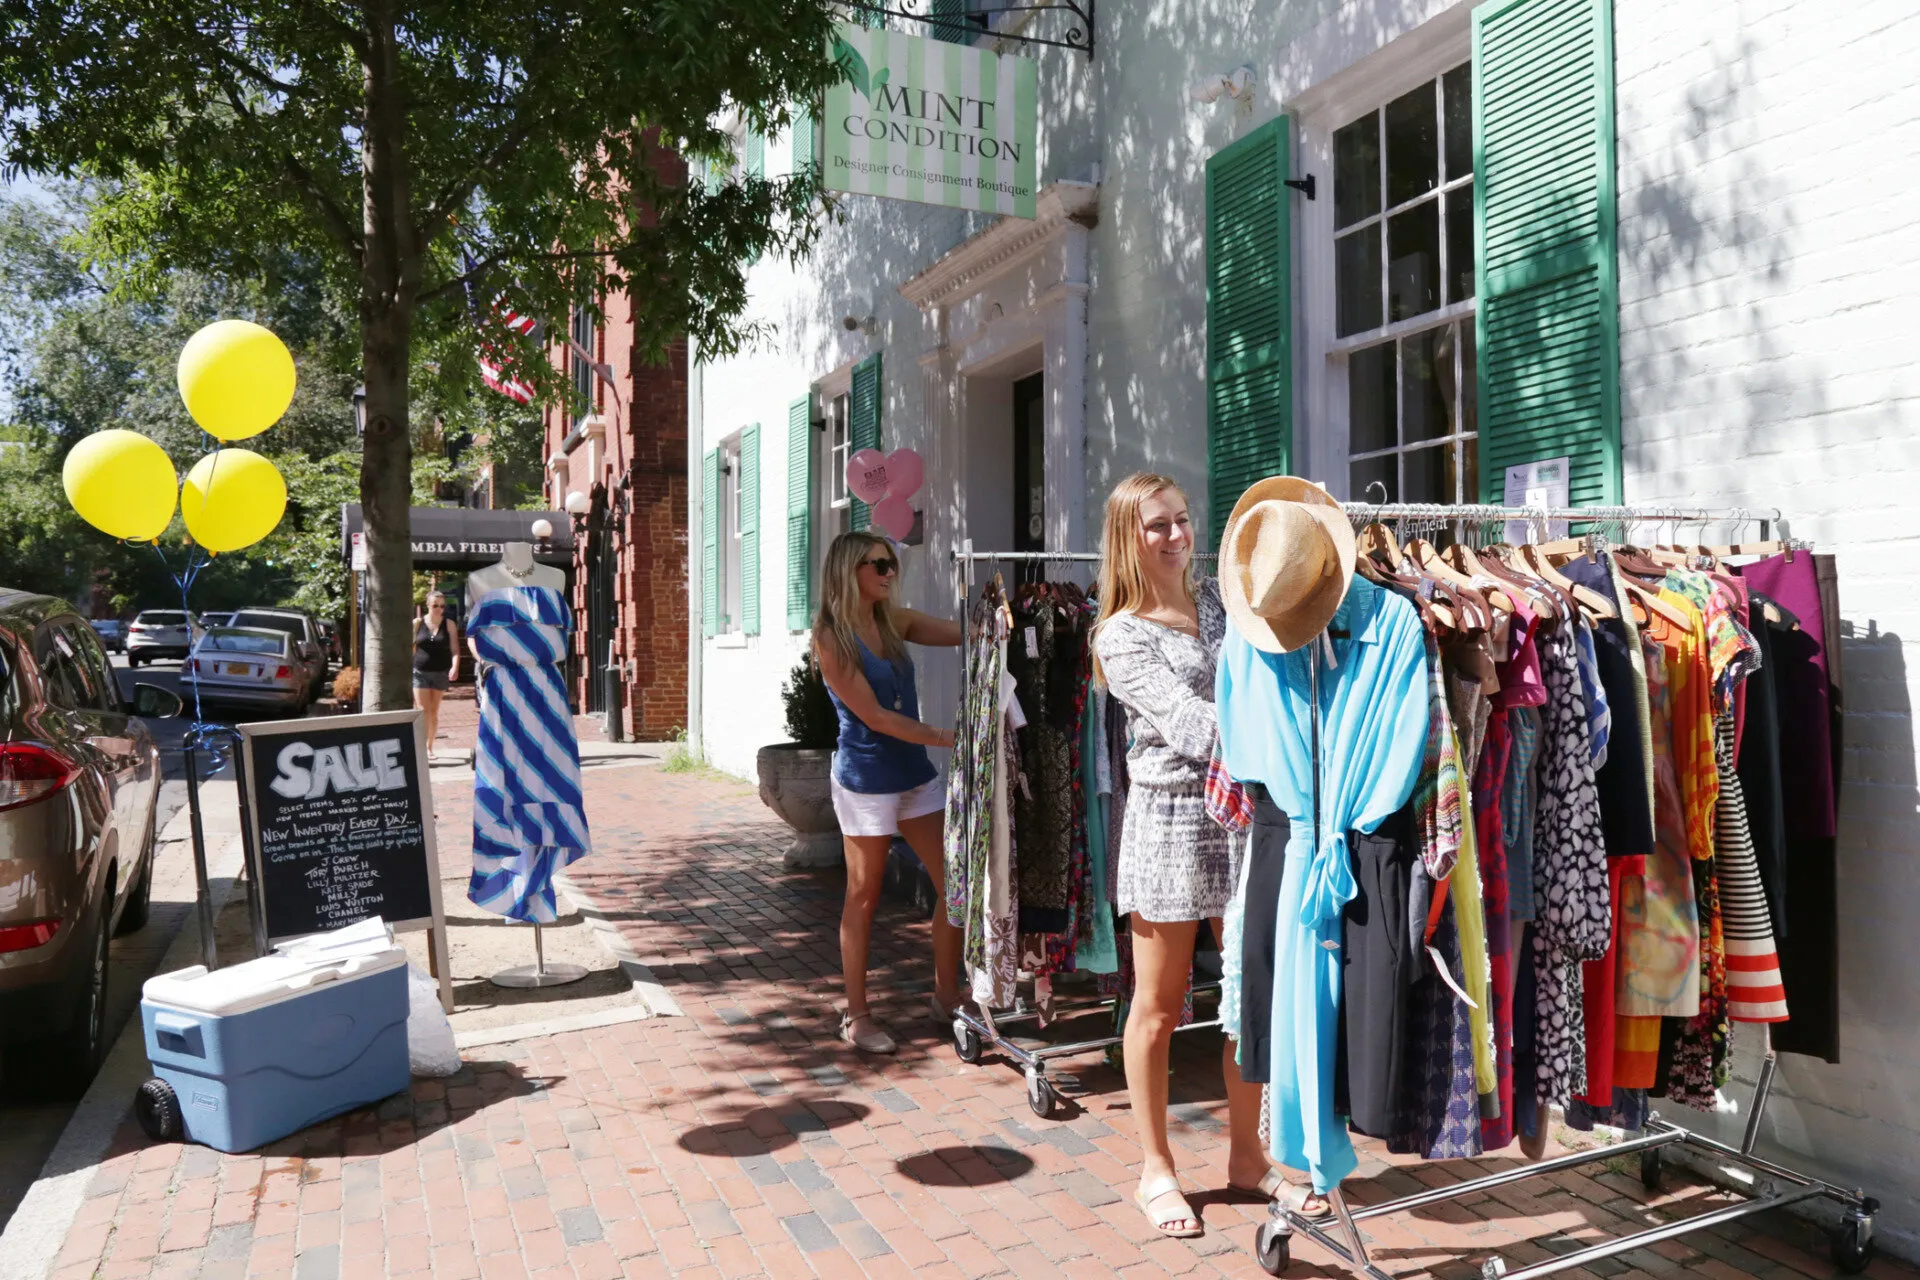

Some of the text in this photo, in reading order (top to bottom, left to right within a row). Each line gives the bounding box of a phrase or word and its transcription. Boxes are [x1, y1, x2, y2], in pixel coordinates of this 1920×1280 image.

[874, 82, 995, 130] MINT
[843, 115, 1021, 164] CONDITION
[833, 155, 1029, 197] Designer Consignment Boutique
[269, 738, 408, 800] SALE
[279, 804, 304, 814] SELECT
[310, 800, 334, 809] ITEMS
[299, 810, 323, 818] ITEMS
[304, 861, 369, 880] TORY BURCH
[307, 870, 381, 889] LILLY PULITZER
[321, 880, 374, 896] KATE SPADE
[328, 890, 358, 902] MILLY
[316, 893, 384, 914] LOUIS VUITTON
[328, 906, 370, 919] CHANEL
